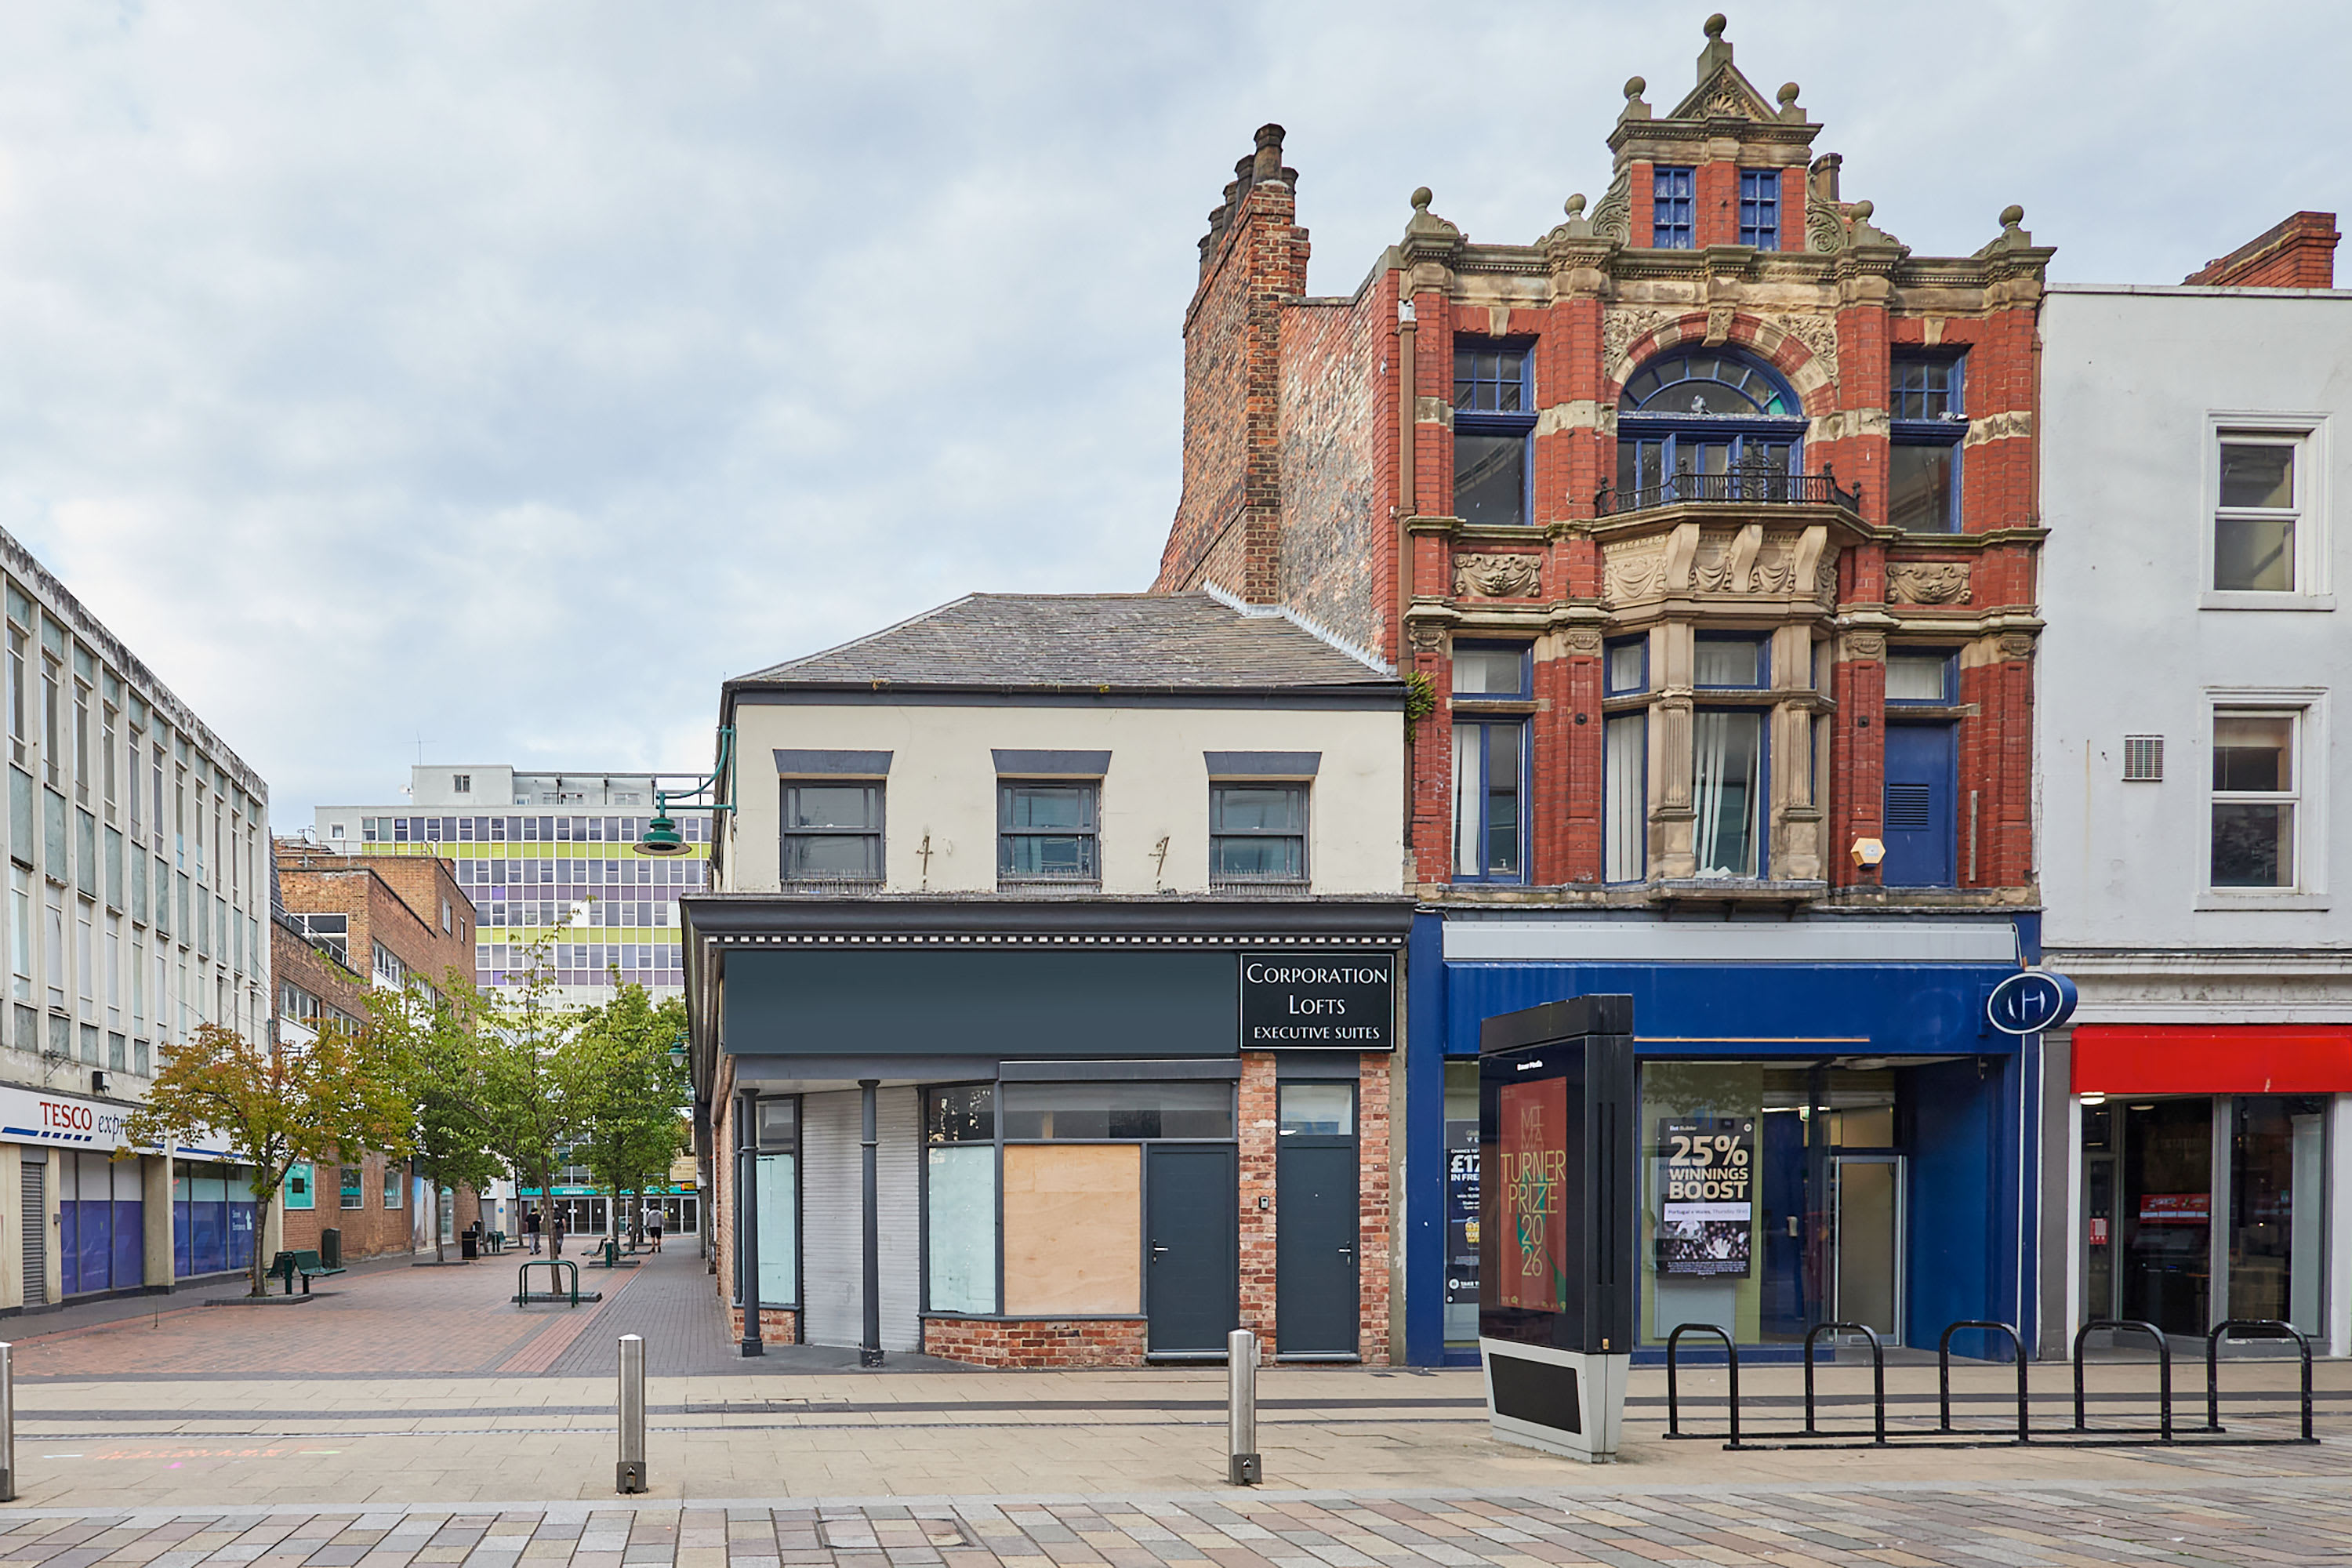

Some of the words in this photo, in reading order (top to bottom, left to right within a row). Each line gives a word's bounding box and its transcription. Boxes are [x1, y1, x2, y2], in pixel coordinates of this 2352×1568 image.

[1247, 963, 1388, 984] CORPORATION
[1288, 994, 1346, 1015] LOFTS
[1254, 1026, 1330, 1040] EXECUTIVE
[1334, 1026, 1381, 1040] SUITES
[39, 1101, 93, 1131] TESCO
[98, 1113, 130, 1142] expr
[1521, 1127, 1544, 1149] MA
[1669, 1134, 1749, 1167] 25%
[1450, 1173, 1461, 1181] IN
[1461, 1173, 1480, 1181] FRE
[1501, 1150, 1566, 1184] TURNER
[1669, 1167, 1749, 1181] WINNINGS
[1508, 1182, 1559, 1214] PRIZE
[1668, 1180, 1749, 1200] BOOST
[1521, 1214, 1544, 1246] 20
[1521, 1245, 1543, 1277] 26
